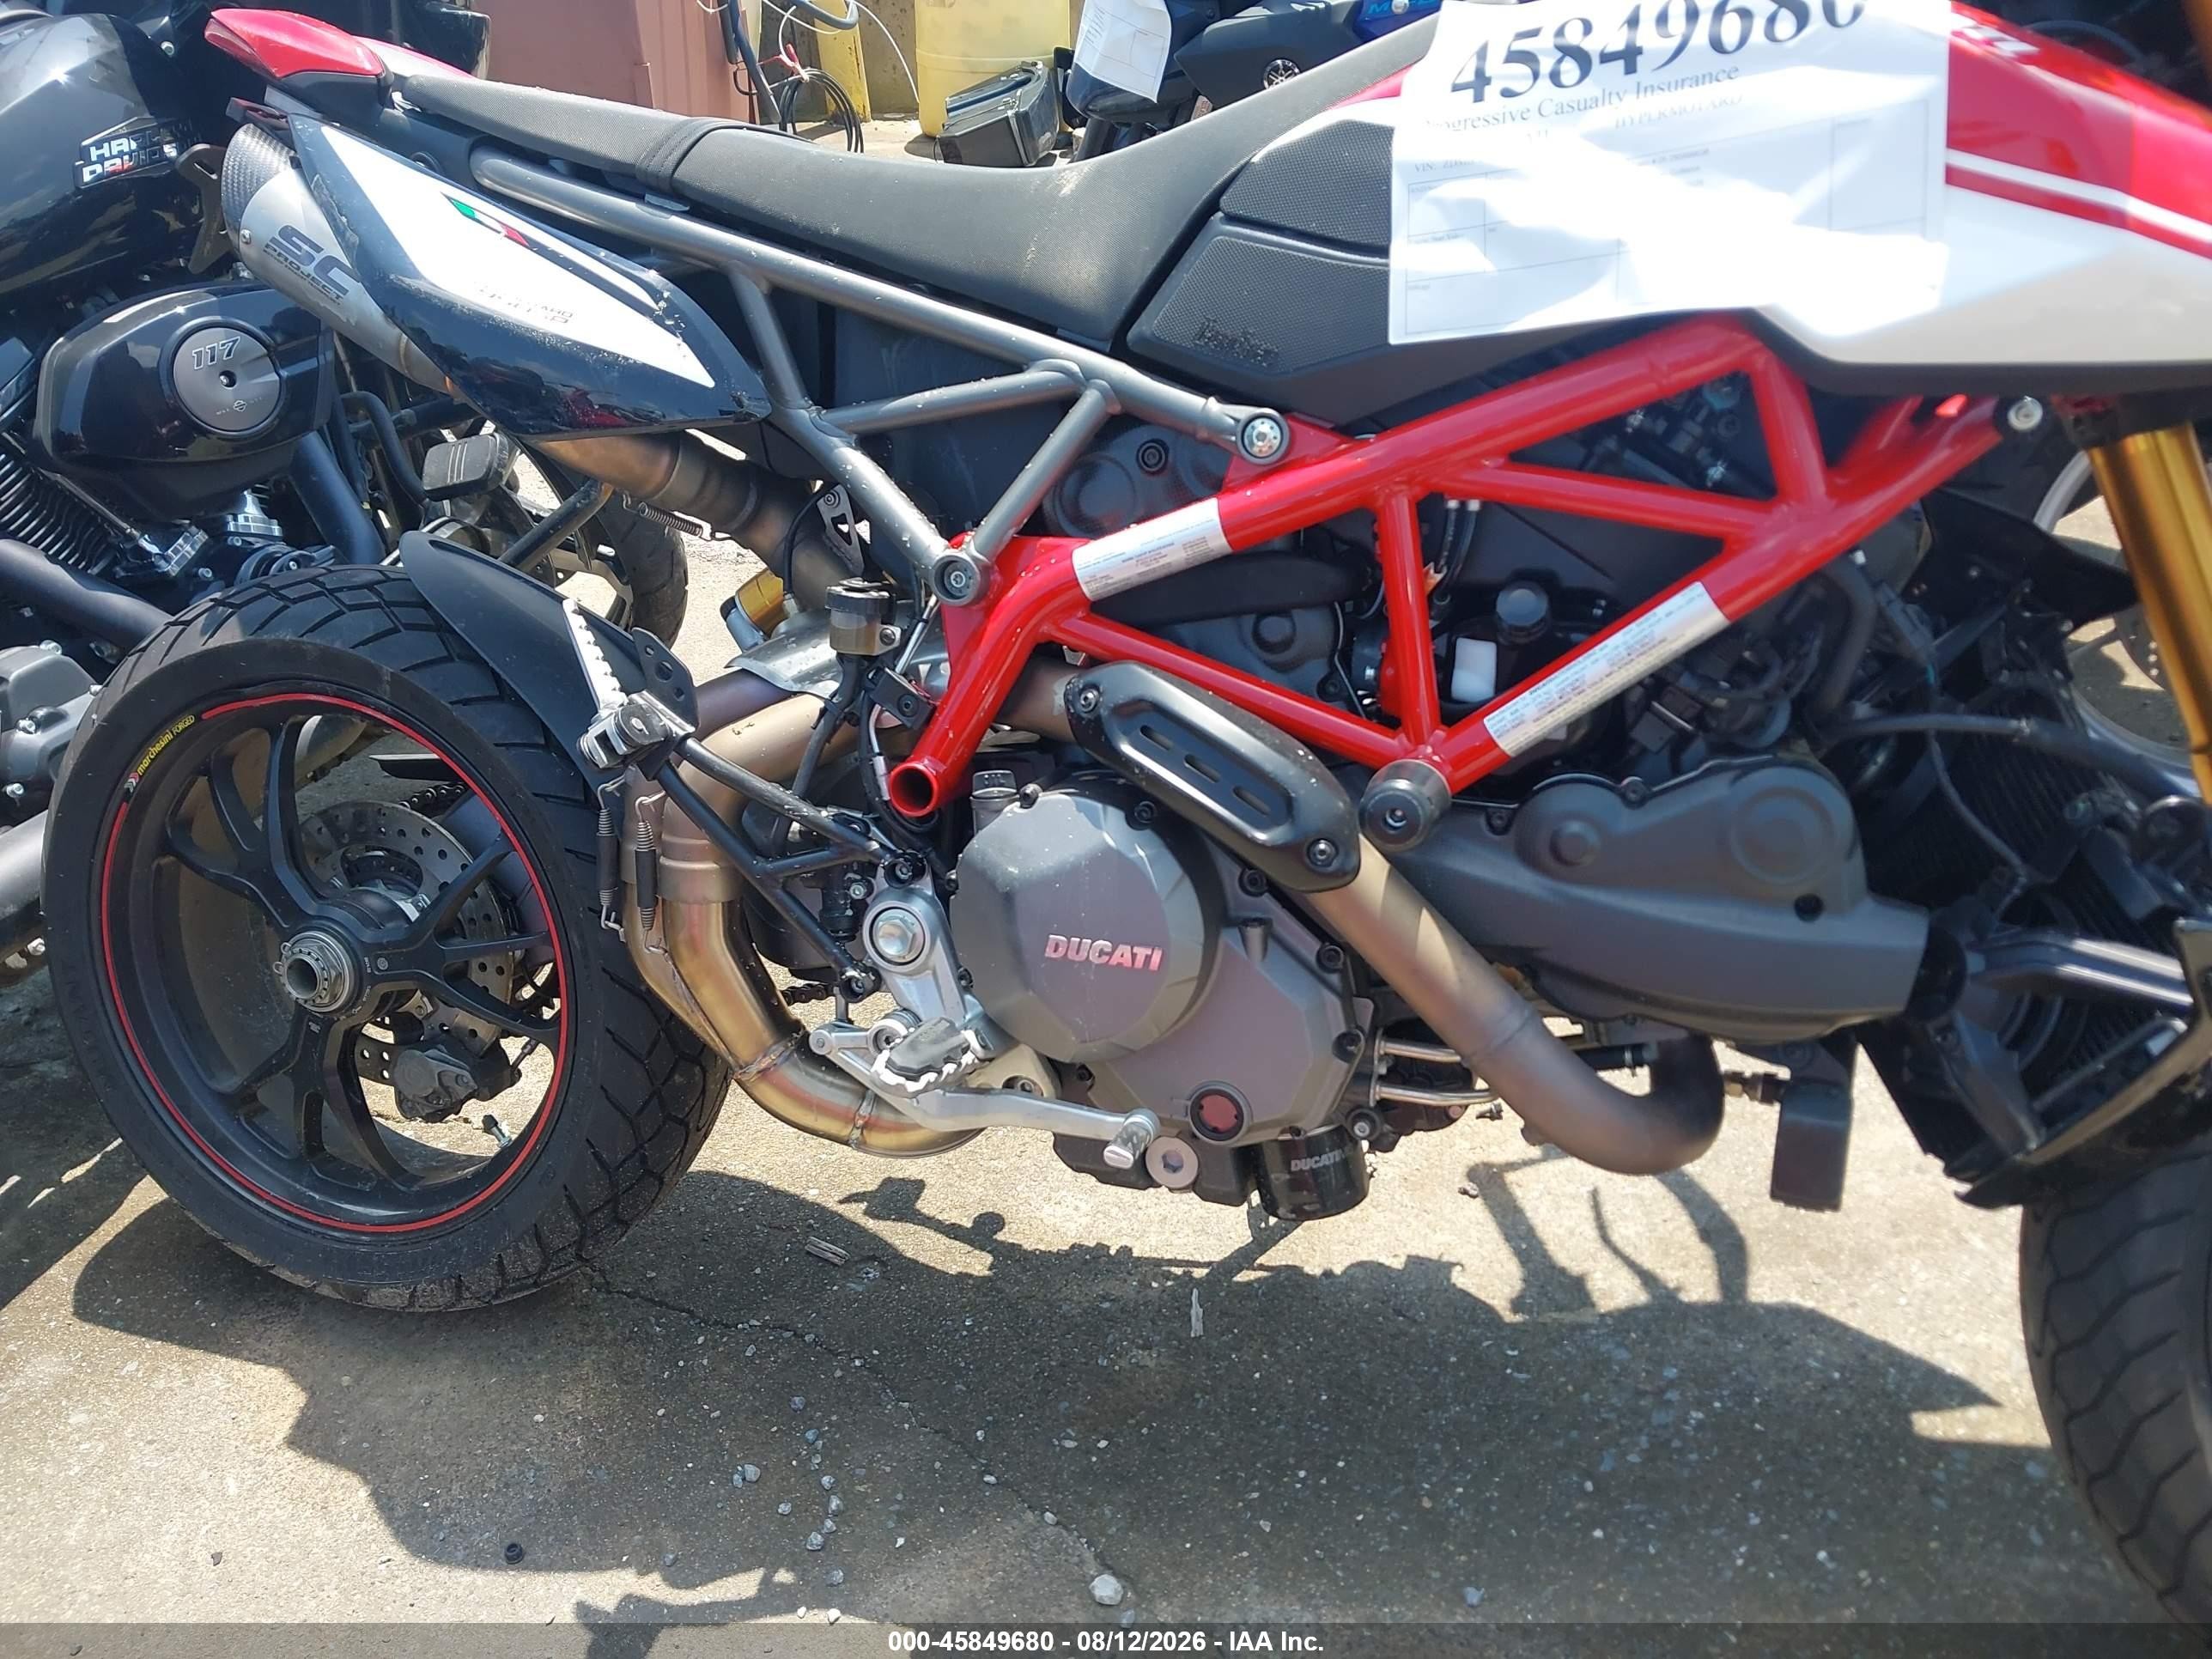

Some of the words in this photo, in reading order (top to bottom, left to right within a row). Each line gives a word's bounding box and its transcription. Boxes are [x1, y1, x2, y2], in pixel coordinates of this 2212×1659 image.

[1538, 88, 1627, 118] Casualty
[1635, 65, 1739, 100] Insurance
[264, 242, 344, 300] PROJECT
[269, 224, 362, 296] SC
[191, 336, 240, 369] 117
[137, 730, 173, 776] marchesini
[172, 714, 195, 736] FORGED
[1044, 934, 1163, 971] DUCATI
